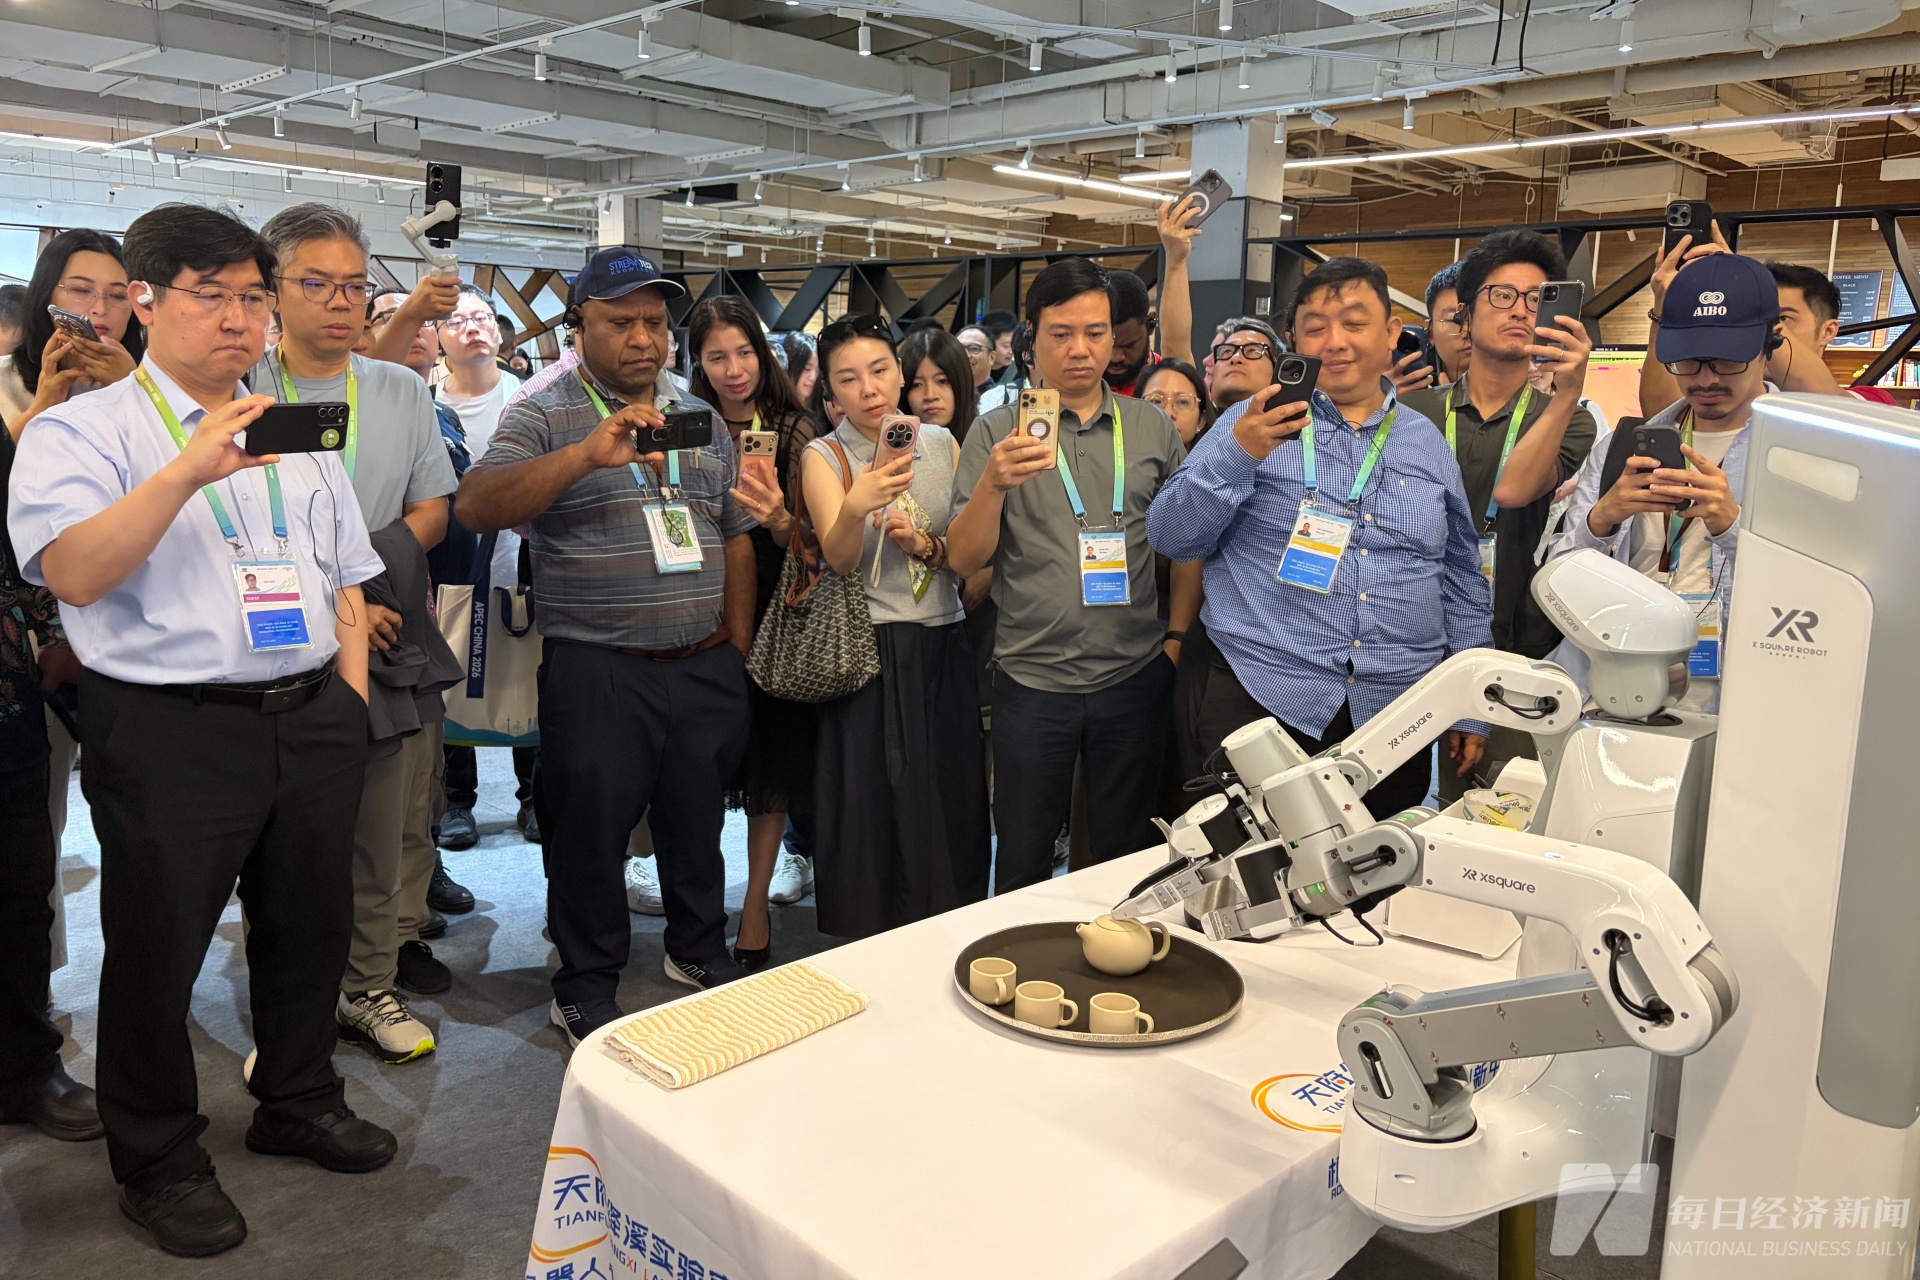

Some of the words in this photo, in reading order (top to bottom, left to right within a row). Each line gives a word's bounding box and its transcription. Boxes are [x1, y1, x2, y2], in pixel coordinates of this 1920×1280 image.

[1692, 305, 1728, 317] AIBO
[474, 601, 485, 625] APEC
[1553, 601, 1580, 632] xsquare
[473, 626, 484, 655] CHINA
[1759, 642, 1795, 653] SQUARE
[1796, 646, 1828, 657] ROBOT
[471, 656, 482, 678] 2026
[1398, 711, 1433, 742] xsquare
[1479, 872, 1536, 894] xsquare
[1291, 1063, 1355, 1107] 天府
